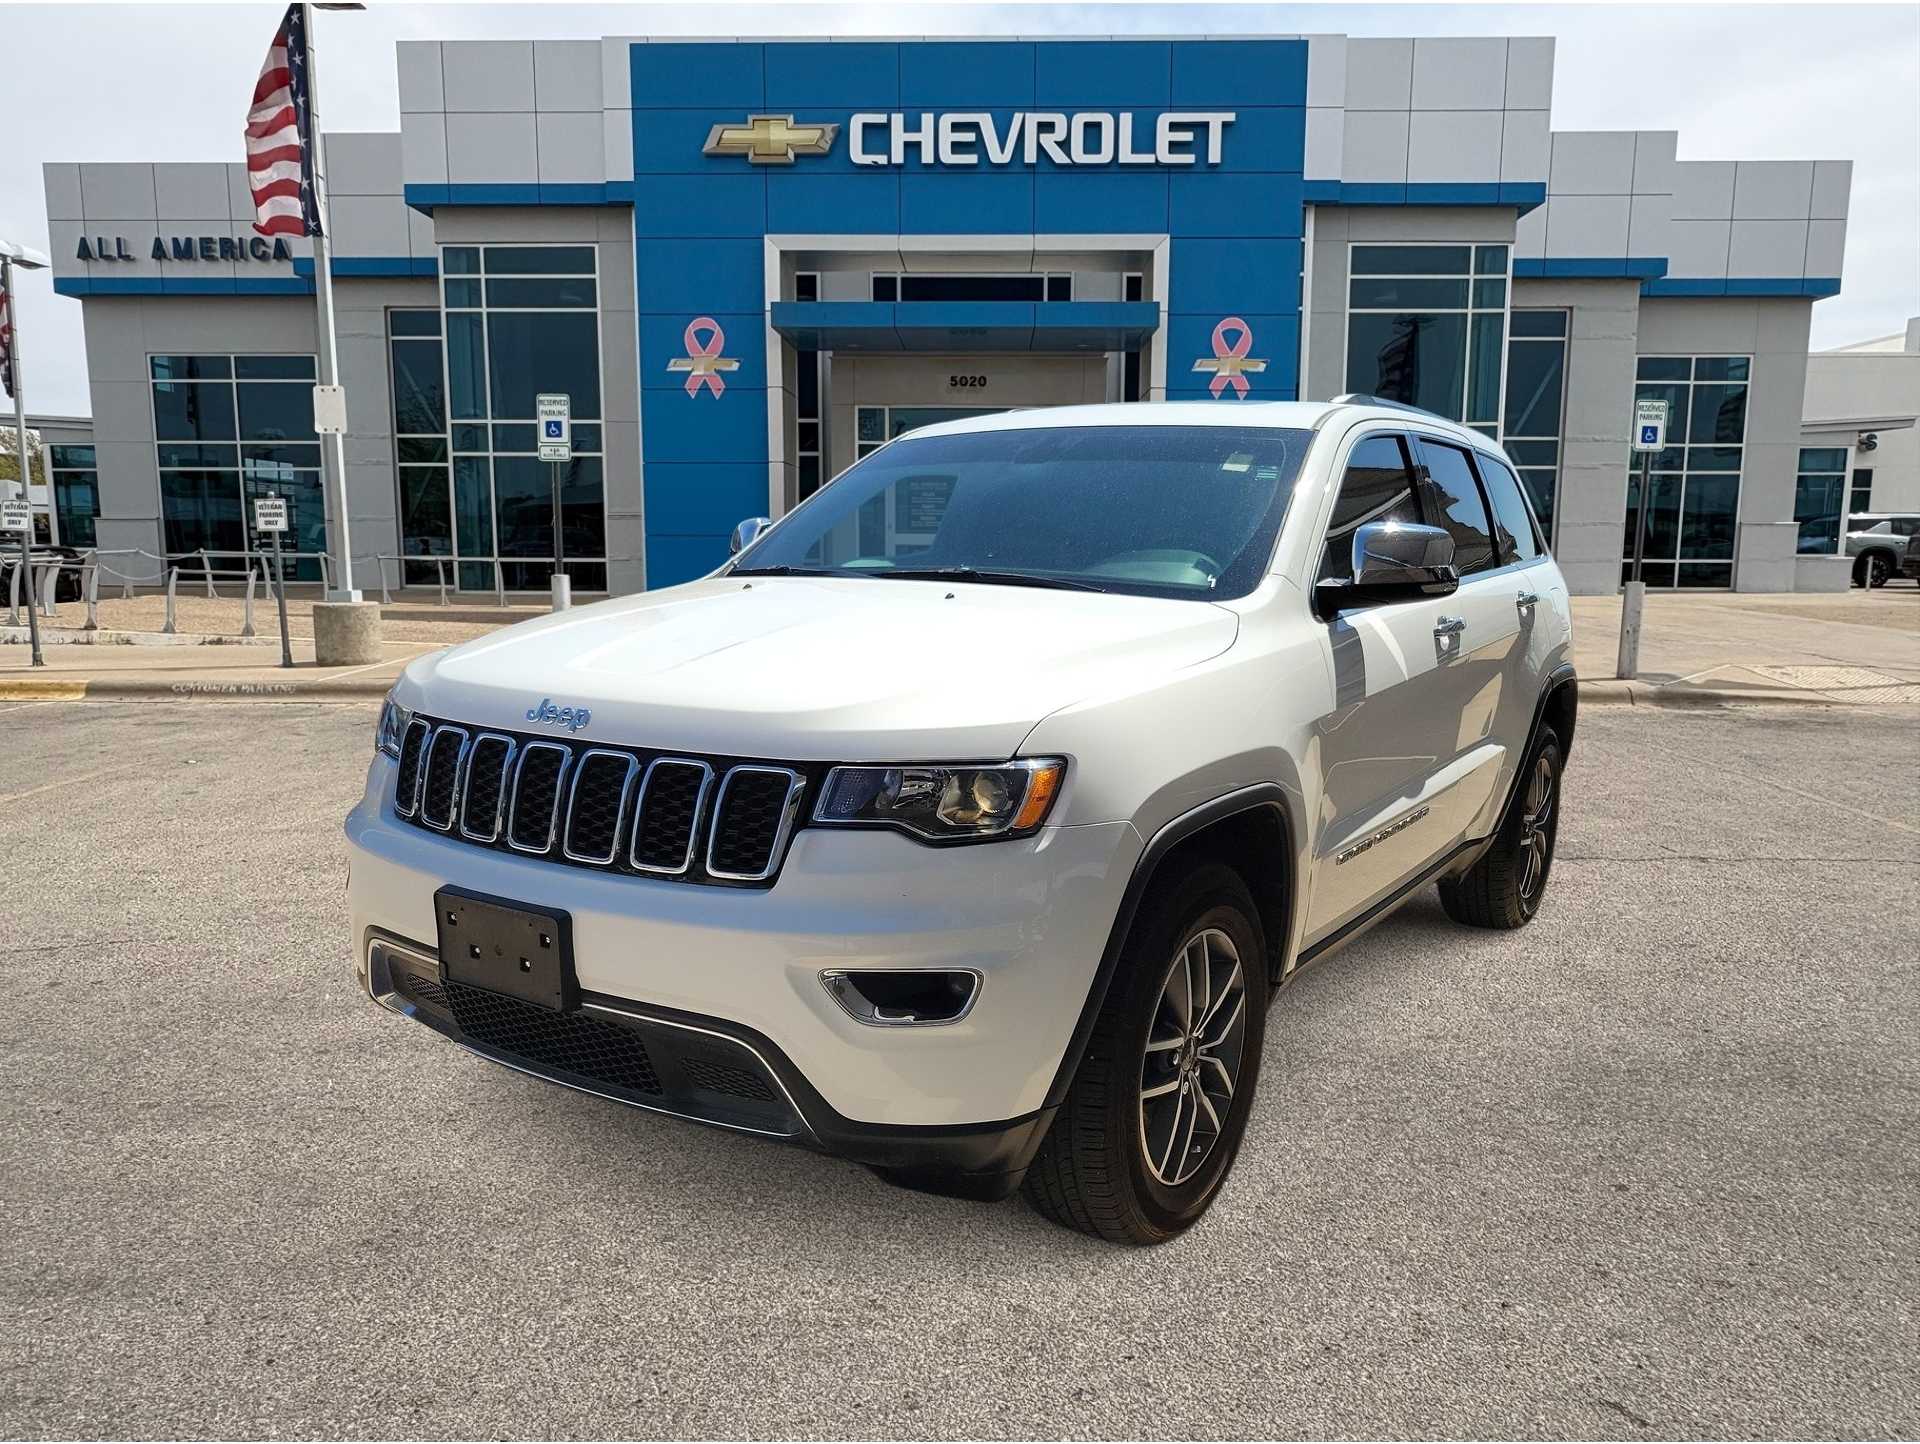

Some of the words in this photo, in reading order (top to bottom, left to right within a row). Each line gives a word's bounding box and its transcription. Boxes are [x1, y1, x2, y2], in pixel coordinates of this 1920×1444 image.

[849, 112, 1237, 165] CHEVROLET
[76, 236, 134, 261] ALL
[949, 375, 987, 388] 5020
[540, 409, 567, 417] PARKING
[527, 698, 592, 734] Jeep
